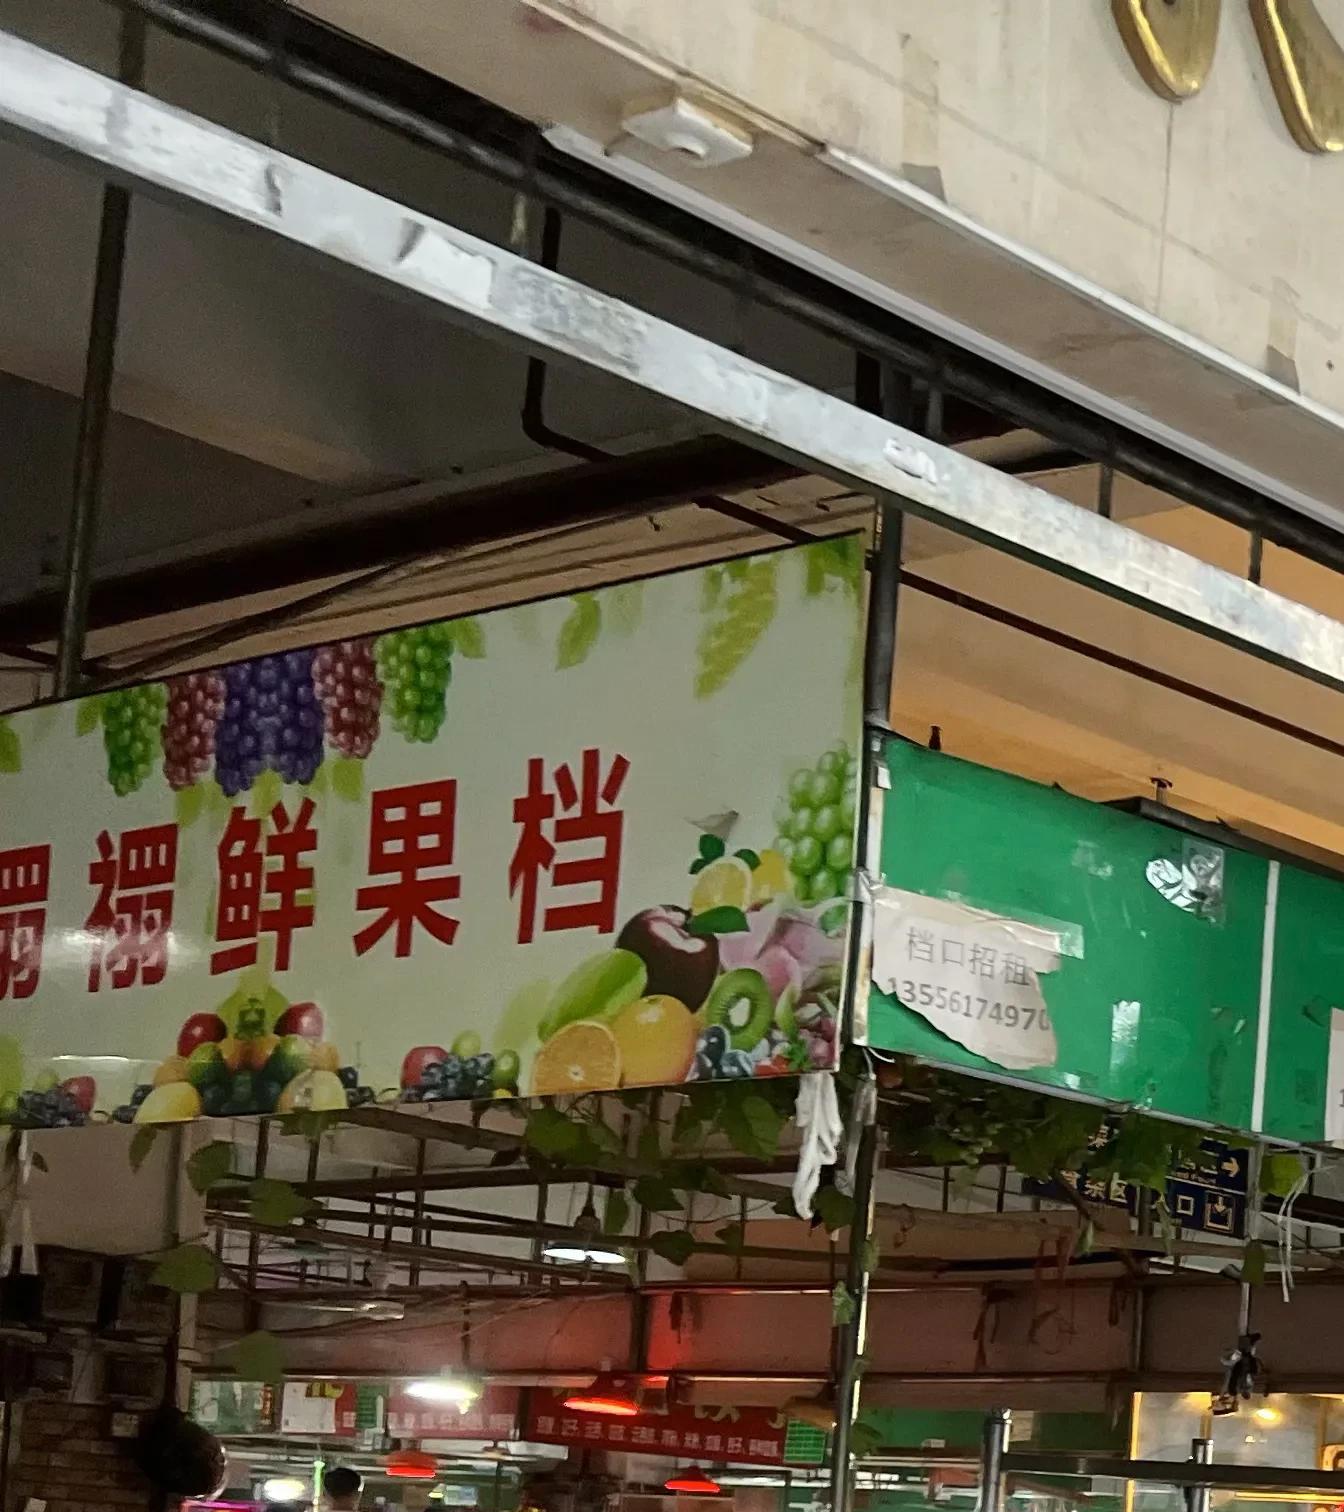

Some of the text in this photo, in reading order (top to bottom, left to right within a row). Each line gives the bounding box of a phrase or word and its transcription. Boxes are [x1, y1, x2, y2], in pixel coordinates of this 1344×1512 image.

[907, 926, 1031, 987] 档口招租
[888, 976, 1050, 1031] 13556174970
